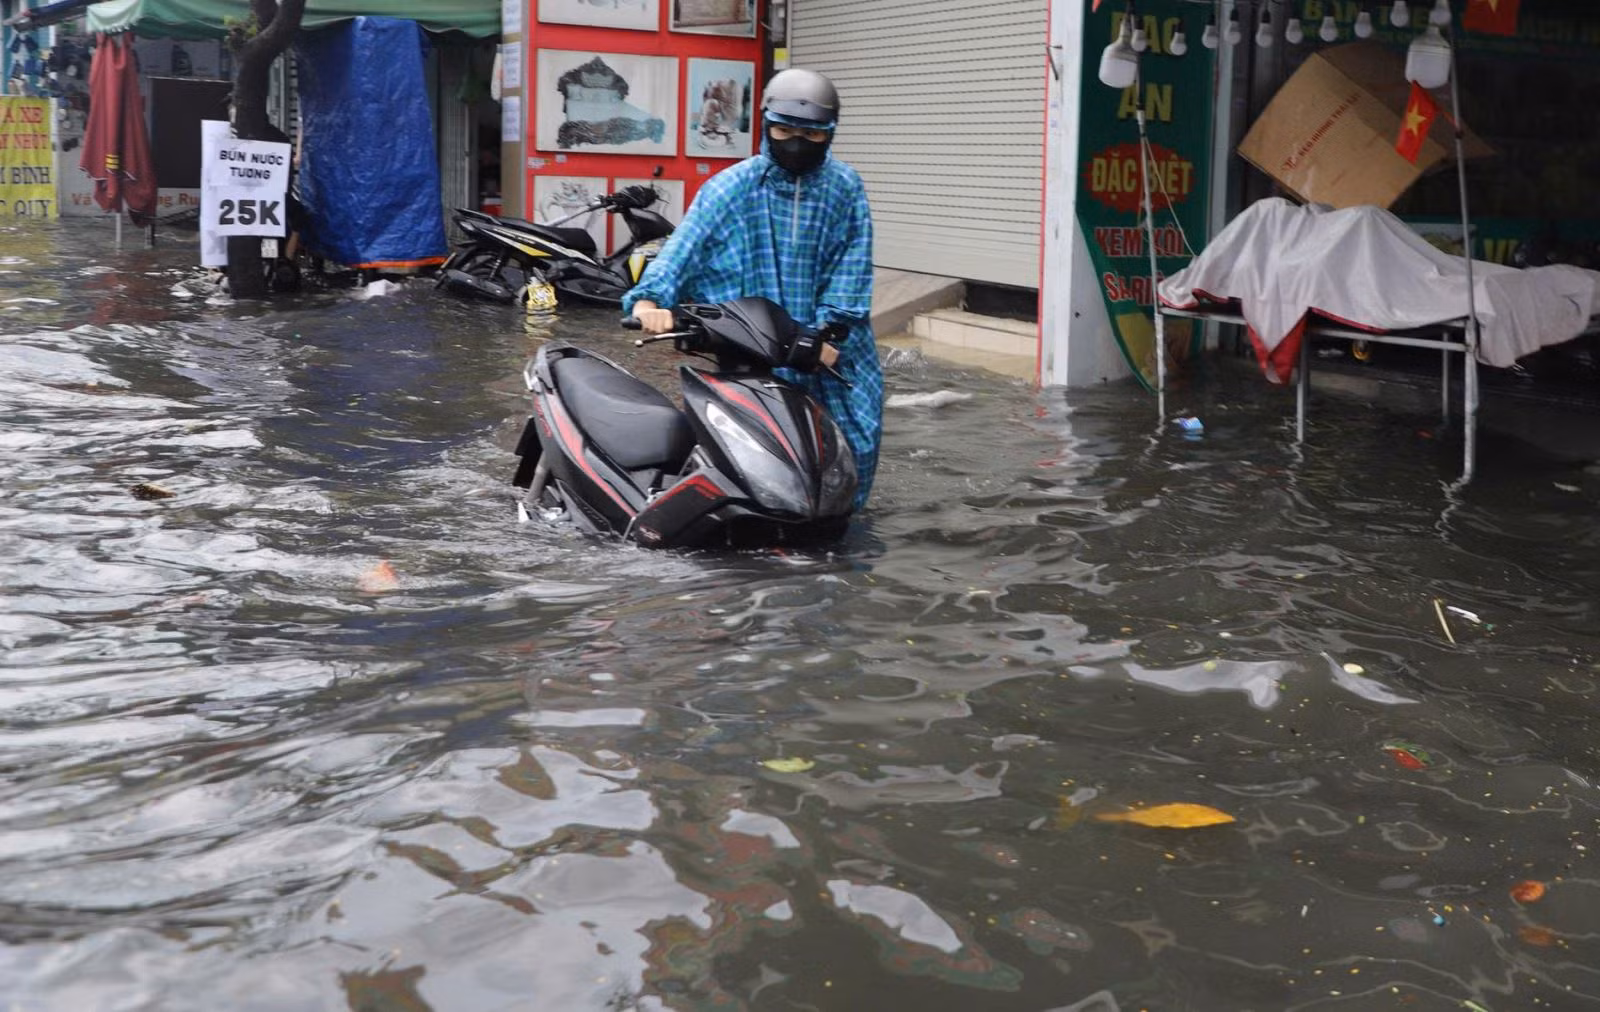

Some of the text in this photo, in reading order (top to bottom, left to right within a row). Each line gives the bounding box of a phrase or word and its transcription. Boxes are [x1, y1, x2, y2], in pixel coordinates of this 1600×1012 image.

[20, 106, 42, 123] XE
[11, 161, 50, 184] BÌNH
[1091, 152, 1194, 201] ĐẶC BIỆT
[218, 198, 281, 226] 25K
